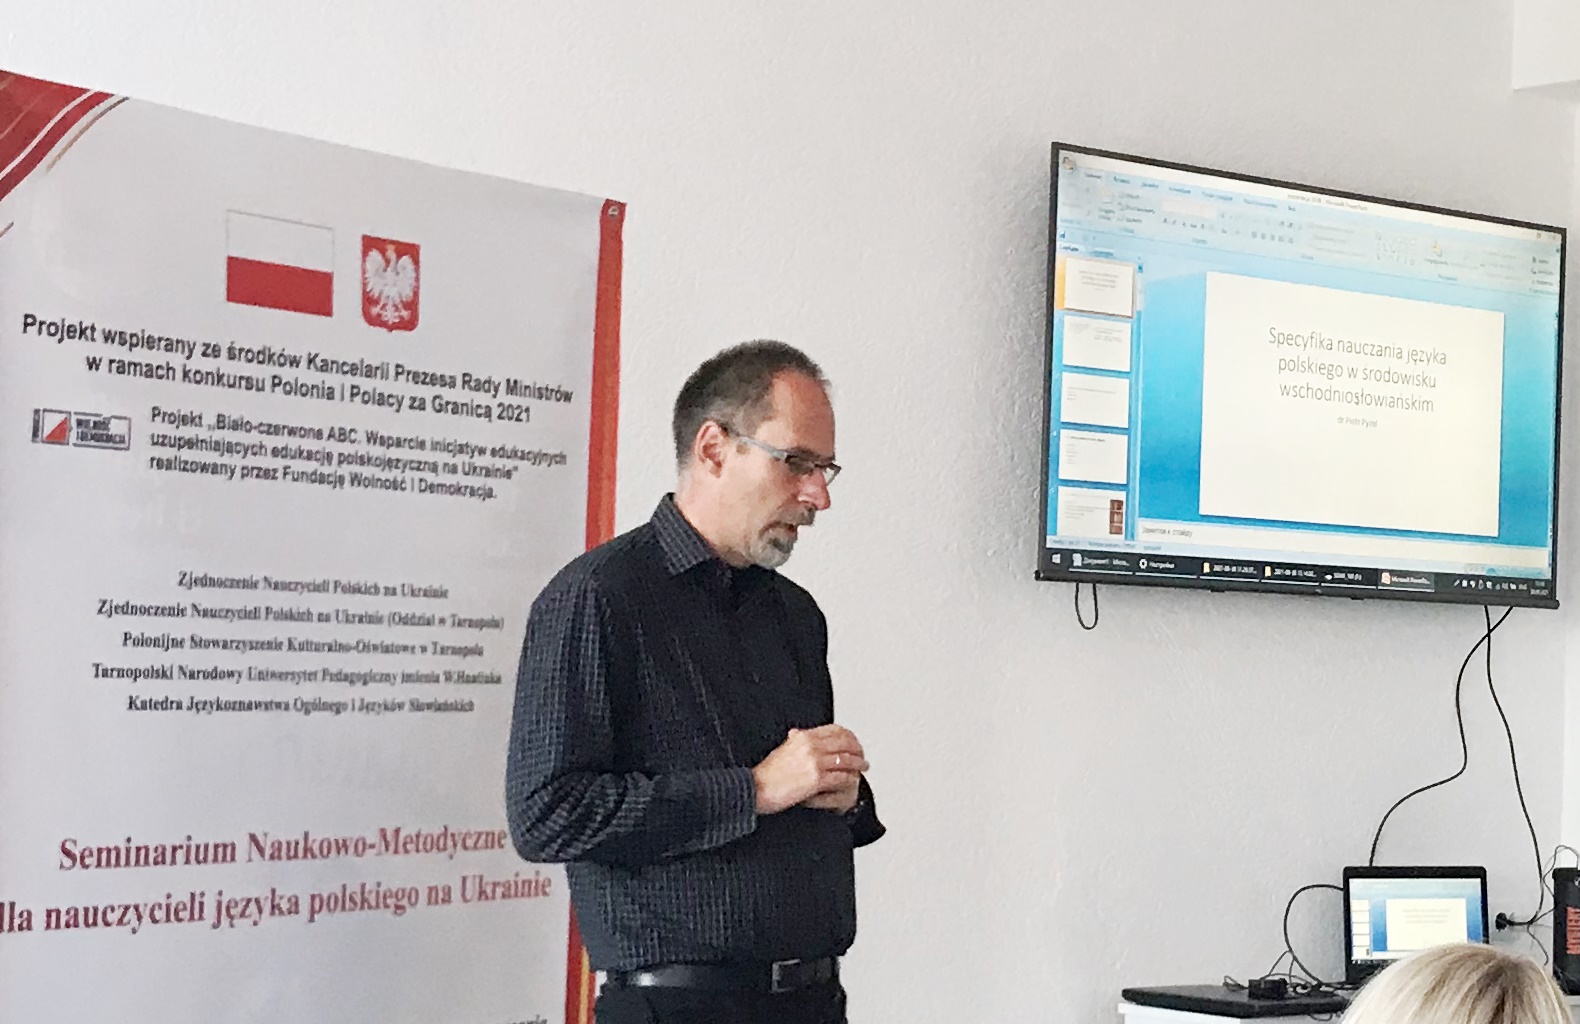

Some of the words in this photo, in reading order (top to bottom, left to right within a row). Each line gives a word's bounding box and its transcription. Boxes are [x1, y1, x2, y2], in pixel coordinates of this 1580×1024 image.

[22, 313, 97, 344] Projekt
[102, 327, 196, 359] wspierany
[201, 342, 222, 359] ze
[227, 341, 303, 368] środków
[307, 352, 390, 381] Kancelarii
[395, 364, 457, 389] Prezesa
[461, 373, 501, 398] Rady
[505, 378, 574, 403] Ministrów
[1269, 327, 1333, 351] Specyfika
[1337, 339, 1403, 359] nauczania
[1406, 345, 1447, 365] języka
[86, 355, 102, 371] w
[108, 357, 176, 381] ramach
[182, 363, 266, 392] konkursu
[271, 374, 335, 400] Polonia
[350, 384, 404, 412] Polacy
[409, 396, 426, 411] za
[432, 394, 492, 423] Granicą
[497, 403, 531, 422] 2021
[1278, 355, 1343, 380] polskiego
[1347, 366, 1358, 378] w
[1362, 364, 1437, 388] środowisku
[1280, 382, 1434, 412] wschodniosłowiańskim
[150, 432, 268, 459] uzupełniających
[271, 442, 334, 466] edukację
[337, 451, 439, 476] polskojęzyczną
[442, 461, 458, 475] na
[152, 406, 203, 430] Projekt
[366, 430, 426, 452] Wsparcie
[430, 436, 487, 458] inicjatyw
[491, 444, 567, 467] edukacyjnych
[150, 456, 237, 481] realizowany
[241, 464, 279, 482] przez
[282, 464, 345, 490] Fundację
[350, 472, 407, 492] Wolność
[177, 570, 259, 590] Zjednoczenie
[262, 574, 330, 595] Nauczycieli
[333, 580, 380, 596] Polskich
[383, 585, 397, 596] na
[401, 583, 449, 598] Ukrainie
[97, 598, 187, 618] Zjednoczenie
[190, 602, 261, 622] Nauczycieli
[264, 606, 313, 622] Polskich
[122, 631, 185, 652] Polonijne
[189, 633, 284, 653] Stowarzyszenie
[92, 662, 174, 683] Tarnopolski
[177, 664, 243, 684] Narodowy
[247, 666, 318, 685] Uniwersytet
[321, 667, 397, 686] Pedagogiczny
[127, 694, 183, 711] Katedra
[186, 695, 290, 715] Językoznawstwa
[293, 696, 348, 716] Ogólnego
[358, 698, 405, 715] Języków
[58, 834, 237, 871] Seminarium
[246, 824, 508, 863] Naukowo-Metodyczne
[44, 890, 206, 935] nauczycieli
[211, 887, 300, 929] języka
[308, 881, 420, 923] polskiego
[426, 883, 452, 906] na
[461, 870, 552, 903] Ukrainie
